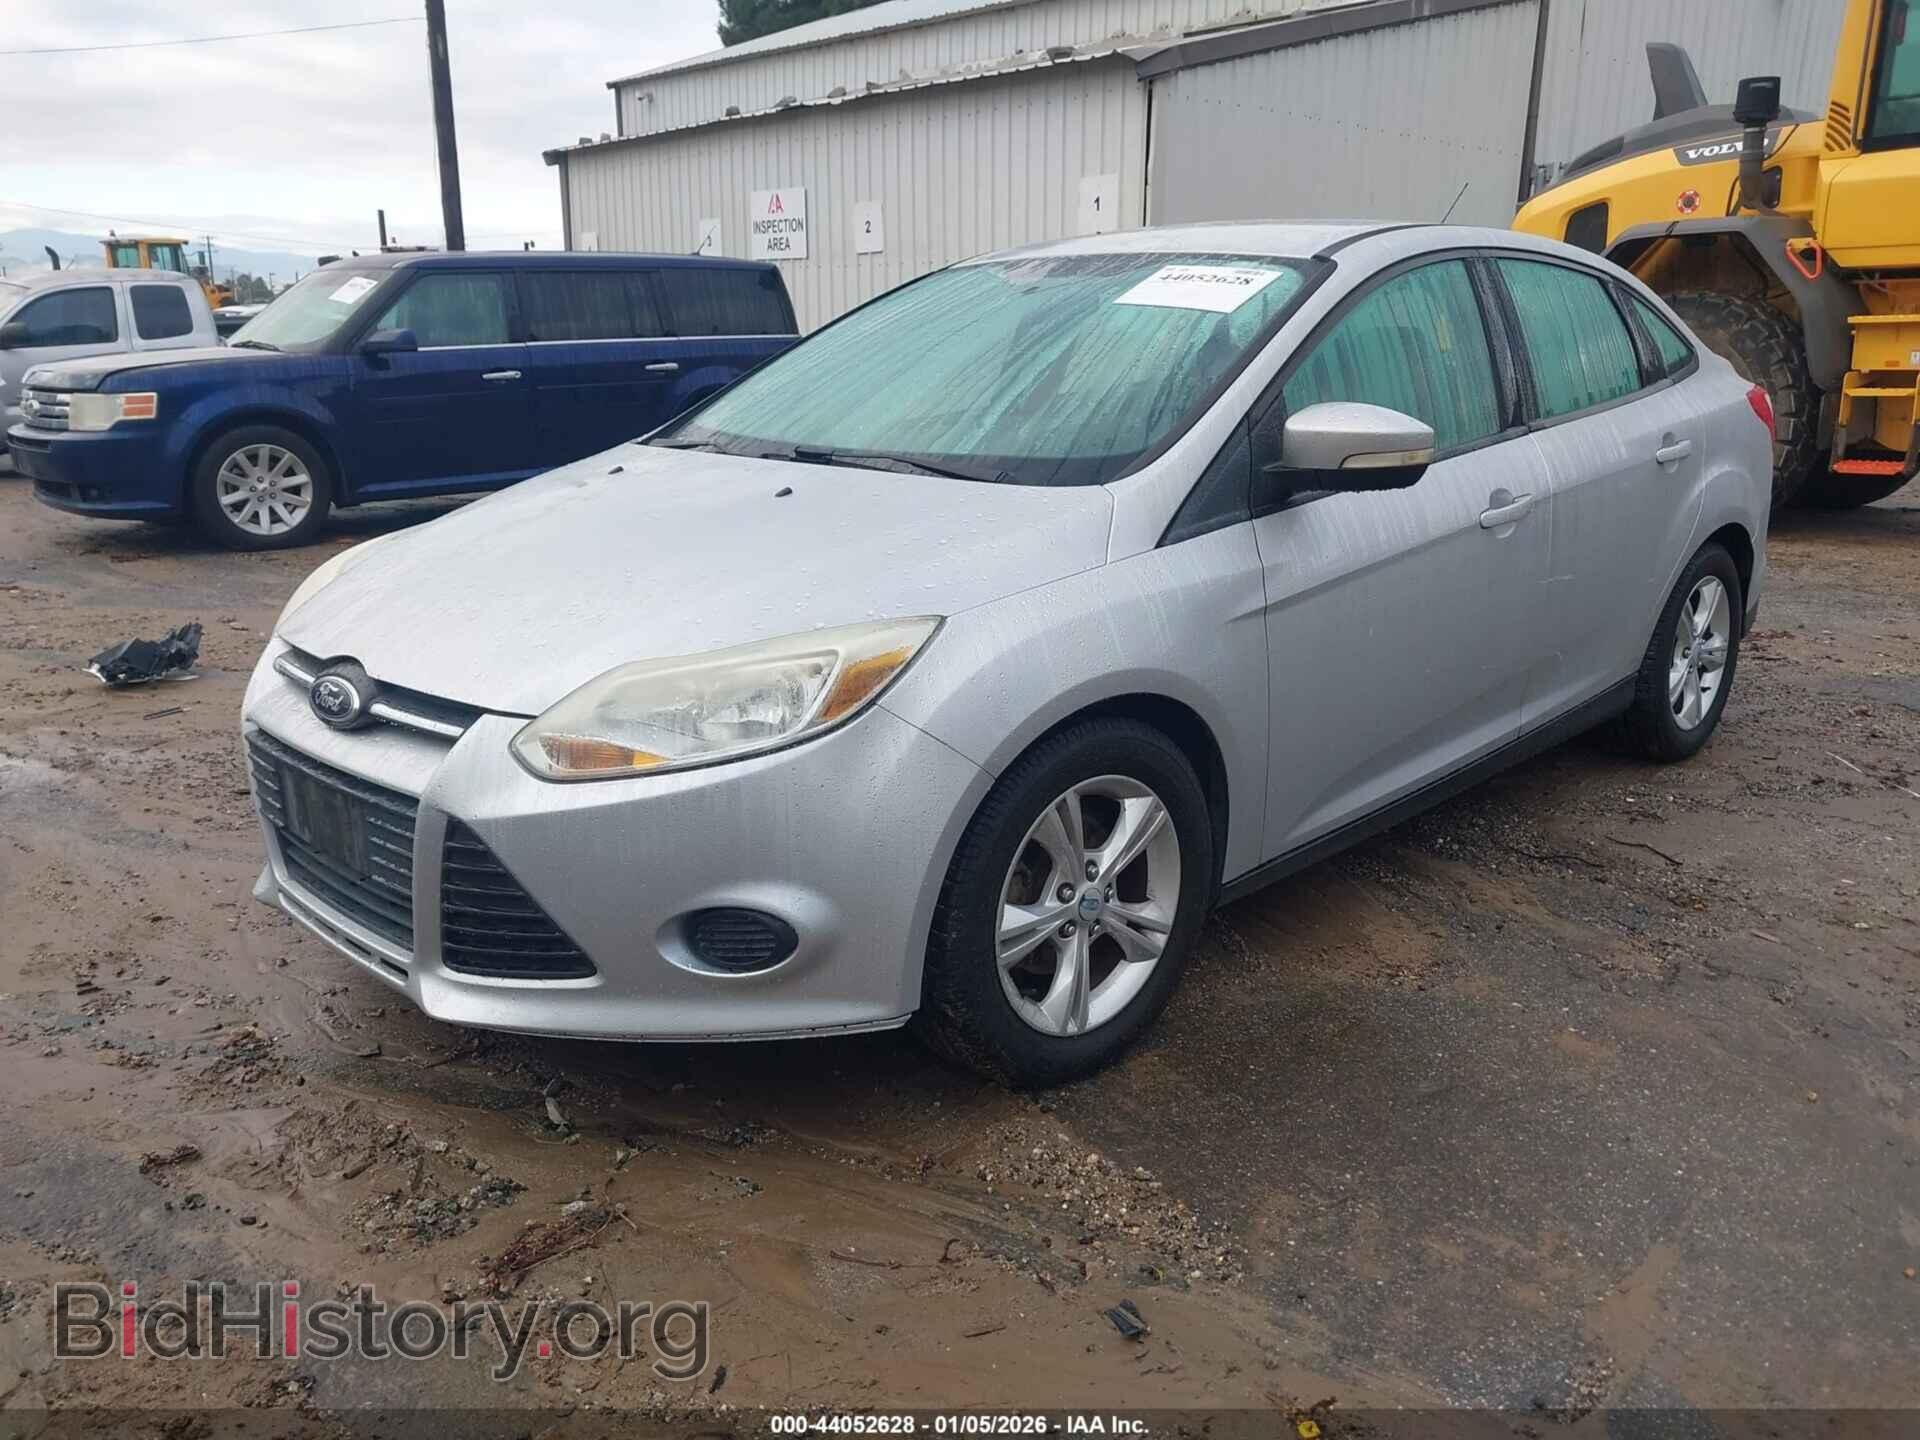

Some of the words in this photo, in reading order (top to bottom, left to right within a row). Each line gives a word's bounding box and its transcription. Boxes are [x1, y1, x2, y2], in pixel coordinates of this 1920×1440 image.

[1094, 196, 1100, 211] 1
[752, 217, 804, 234] INSPECTION
[864, 220, 872, 233] 2
[767, 236, 791, 251] AREA
